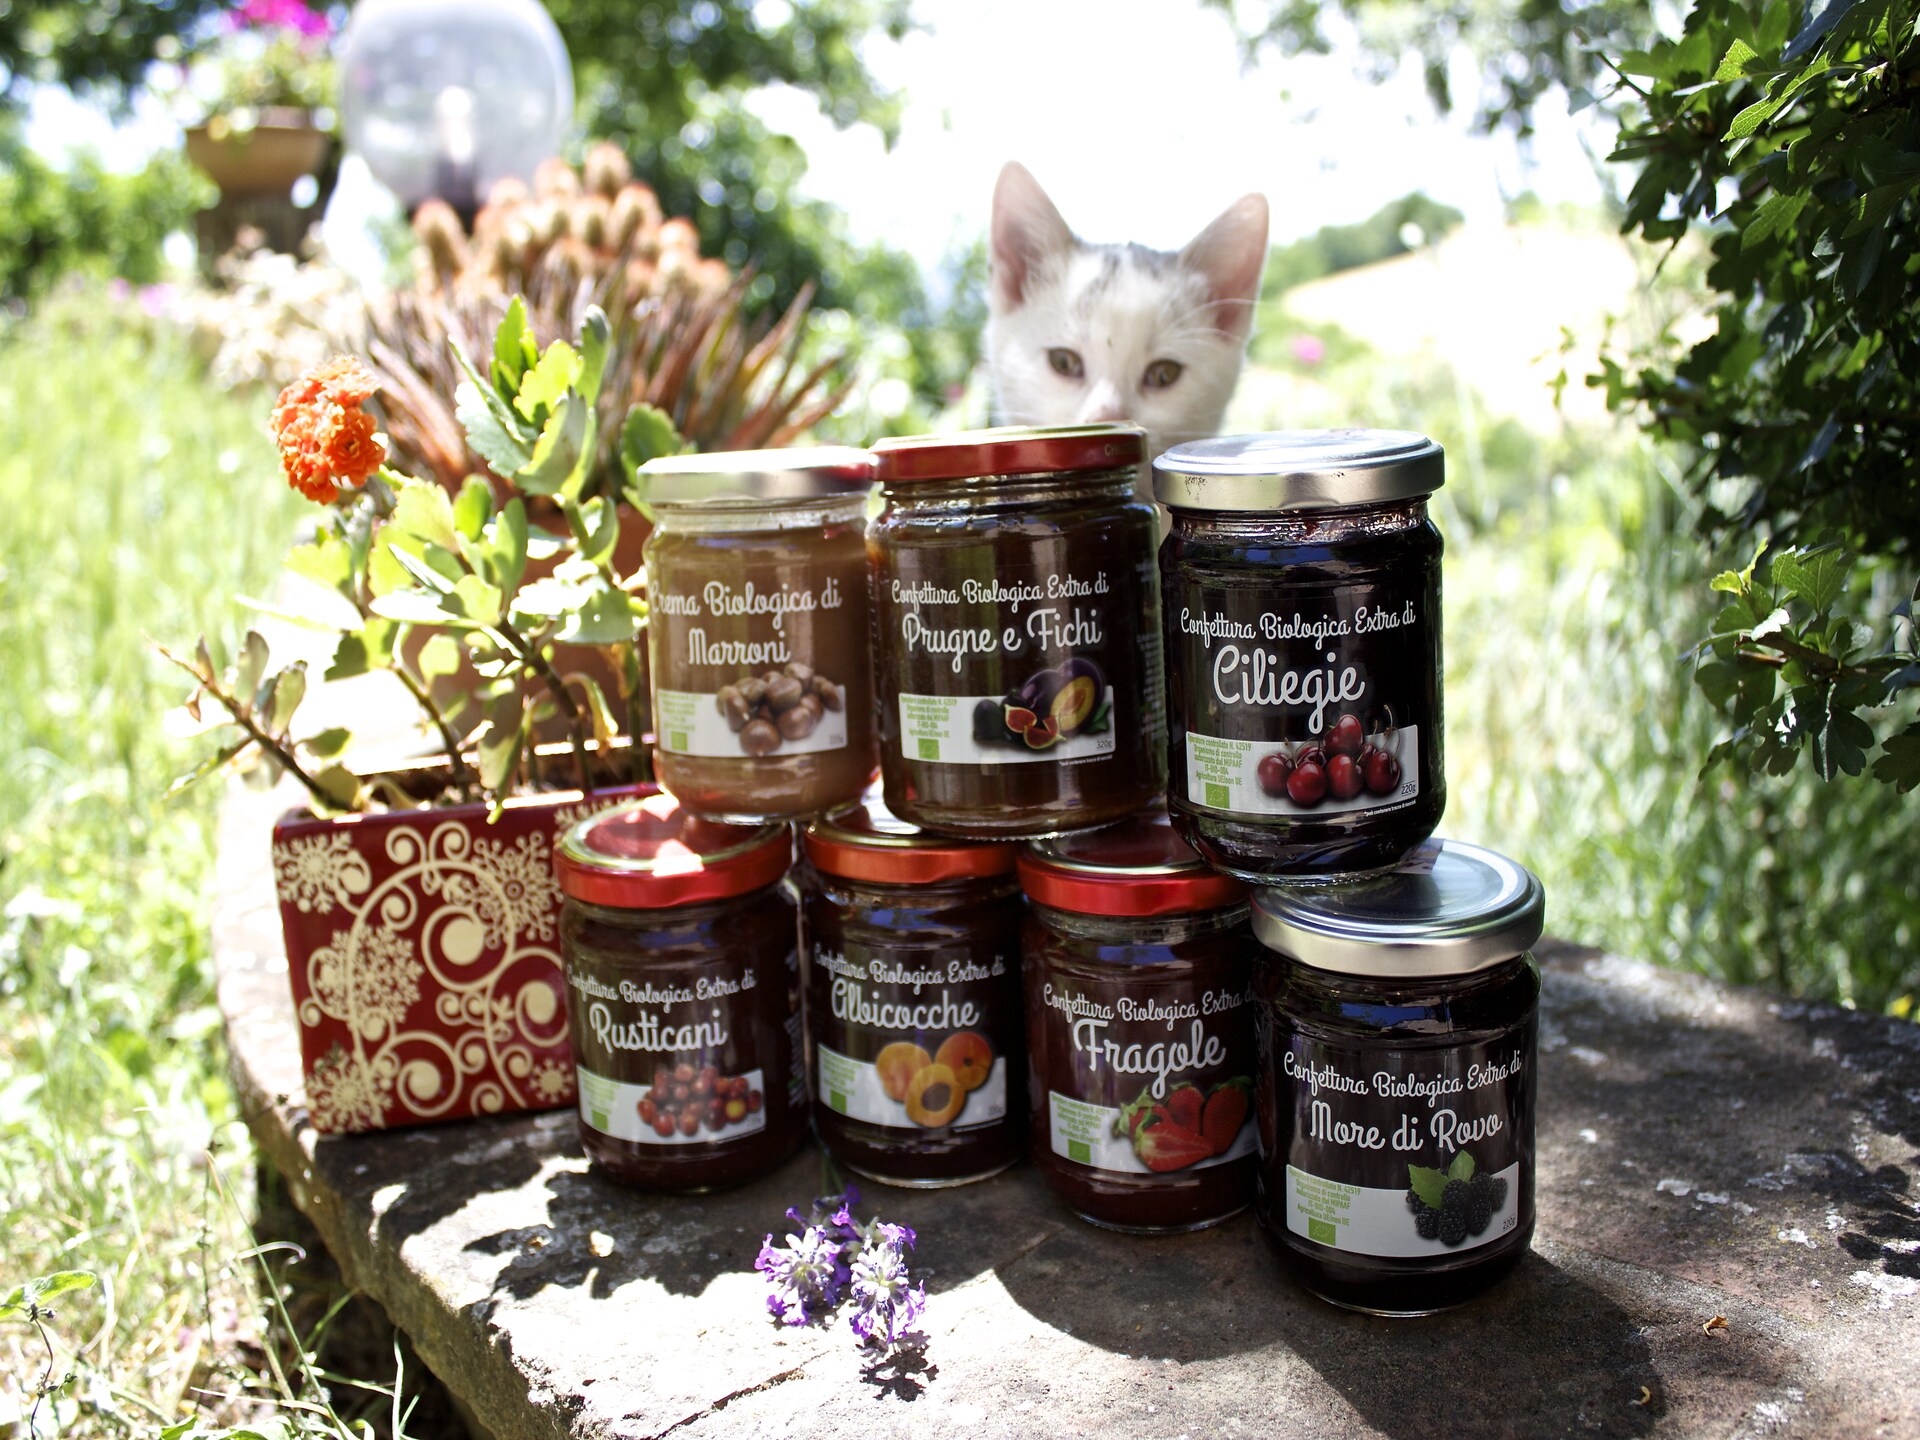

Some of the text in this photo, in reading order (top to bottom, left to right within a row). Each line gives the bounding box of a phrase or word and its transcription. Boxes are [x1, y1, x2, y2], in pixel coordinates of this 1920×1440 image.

[703, 580, 816, 630] Biologica
[821, 577, 842, 608] di
[892, 579, 960, 613] Confettura
[962, 578, 1044, 613] Biologica
[1047, 574, 1092, 598] Extra
[1094, 572, 1109, 594] di
[689, 628, 791, 666] Marroni
[903, 608, 1102, 673] Prugne e Fichi
[1180, 600, 1416, 650] Confettura Biologica Extra di
[1213, 645, 1366, 734] Ciliegie
[1236, 742, 1251, 752] 42519
[1402, 784, 1416, 795] 220g
[620, 980, 694, 1014] Biologica
[696, 976, 740, 1000] Extra
[741, 969, 756, 990] di
[814, 942, 868, 980] Confettura
[869, 960, 945, 995] Biologica
[948, 960, 990, 984] Extra
[991, 955, 1006, 976] di
[588, 1002, 728, 1054] Rusticani
[831, 978, 980, 1030] Albicocche
[1043, 980, 1256, 1031] Confettura Biologica Extra d
[1073, 1018, 1226, 1100] Fragole
[1284, 1050, 1522, 1108] Confettura Biologica Extra di
[1310, 1100, 1503, 1154] More di Rovo
[1344, 1185, 1360, 1196] 42519
[1502, 1217, 1516, 1230] 220g
